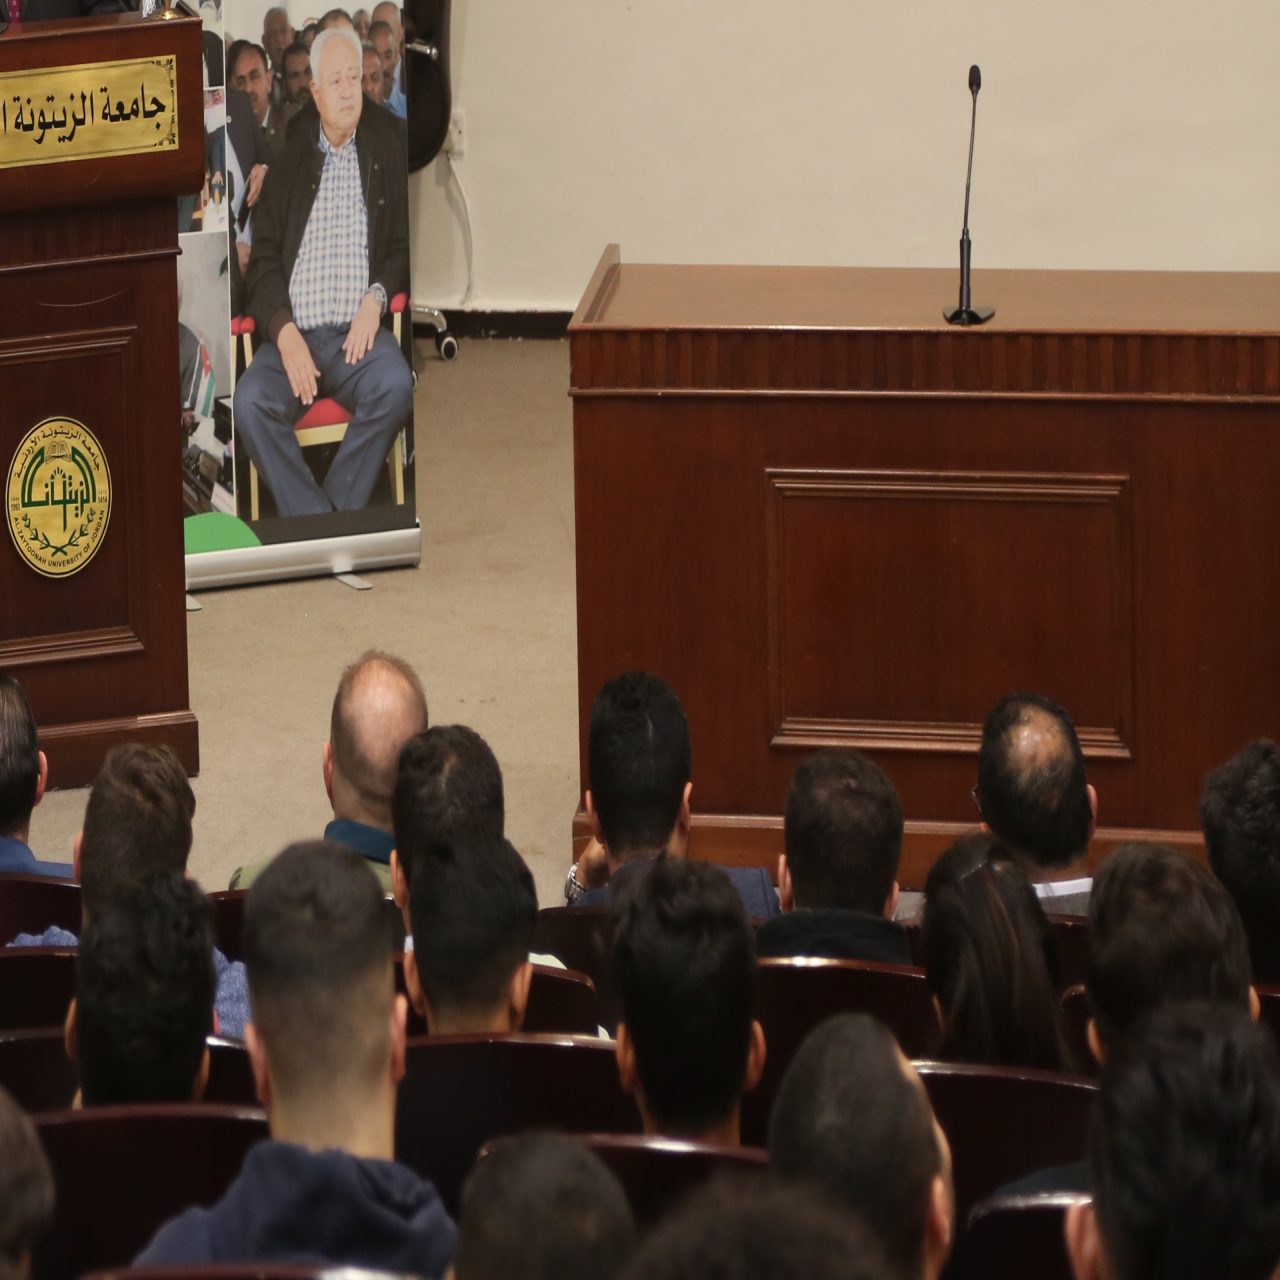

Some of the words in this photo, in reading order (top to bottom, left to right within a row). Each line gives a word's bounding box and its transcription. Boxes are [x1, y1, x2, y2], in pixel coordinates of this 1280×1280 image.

[12, 89, 94, 144] الزيتونة
[100, 82, 166, 130] جامعة
[47, 552, 83, 567] UNIVERSITY
[83, 542, 91, 553] OF
[92, 509, 105, 543] JORDAN
